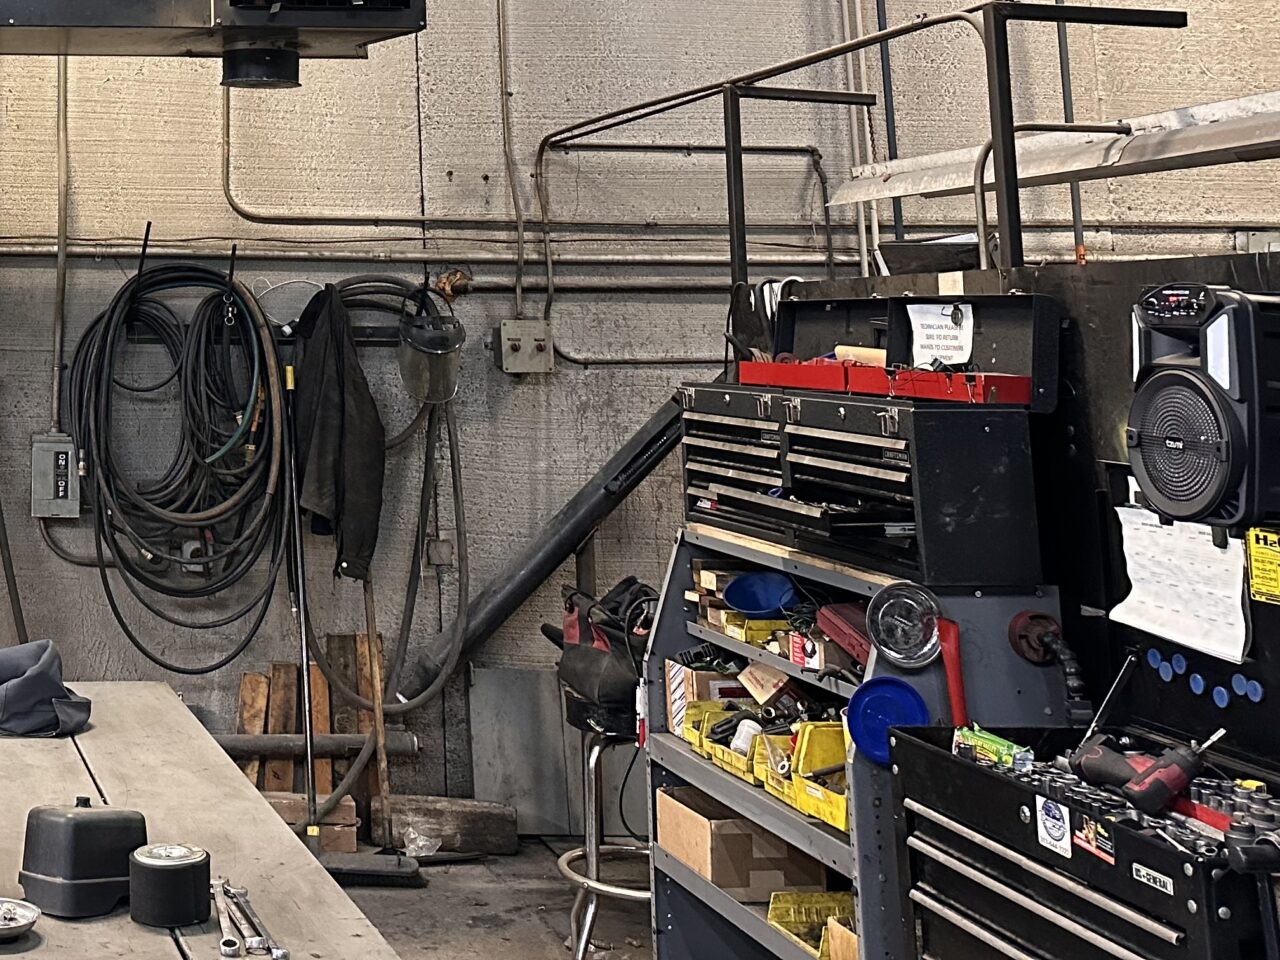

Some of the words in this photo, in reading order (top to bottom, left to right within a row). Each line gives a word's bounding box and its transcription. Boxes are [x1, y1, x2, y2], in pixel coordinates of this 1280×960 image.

[58, 453, 66, 465] ON
[58, 480, 66, 497] OFF
[1255, 533, 1280, 547] H2
